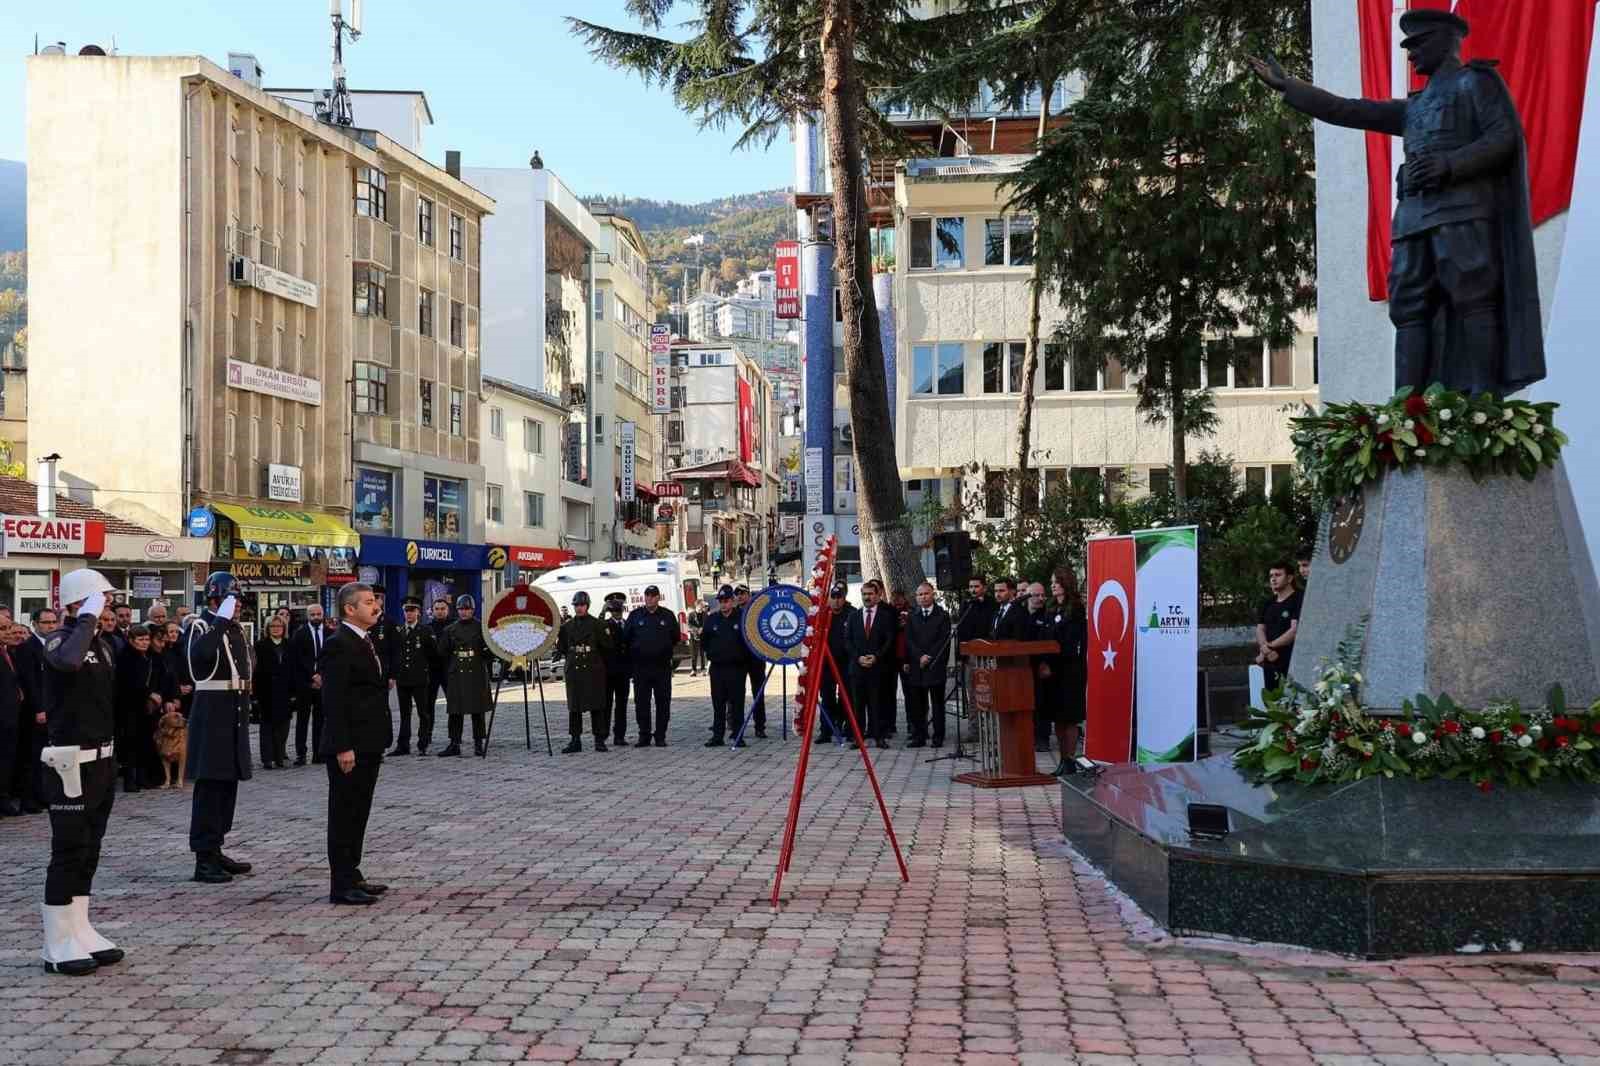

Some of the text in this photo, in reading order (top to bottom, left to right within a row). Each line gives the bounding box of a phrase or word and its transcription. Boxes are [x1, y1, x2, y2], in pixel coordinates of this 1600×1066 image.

[656, 367, 666, 406] KURS
[4, 519, 82, 540] ECZANE
[420, 547, 454, 561] TURKCELL
[517, 551, 544, 561] AKBANK
[1168, 605, 1184, 615] T.C.
